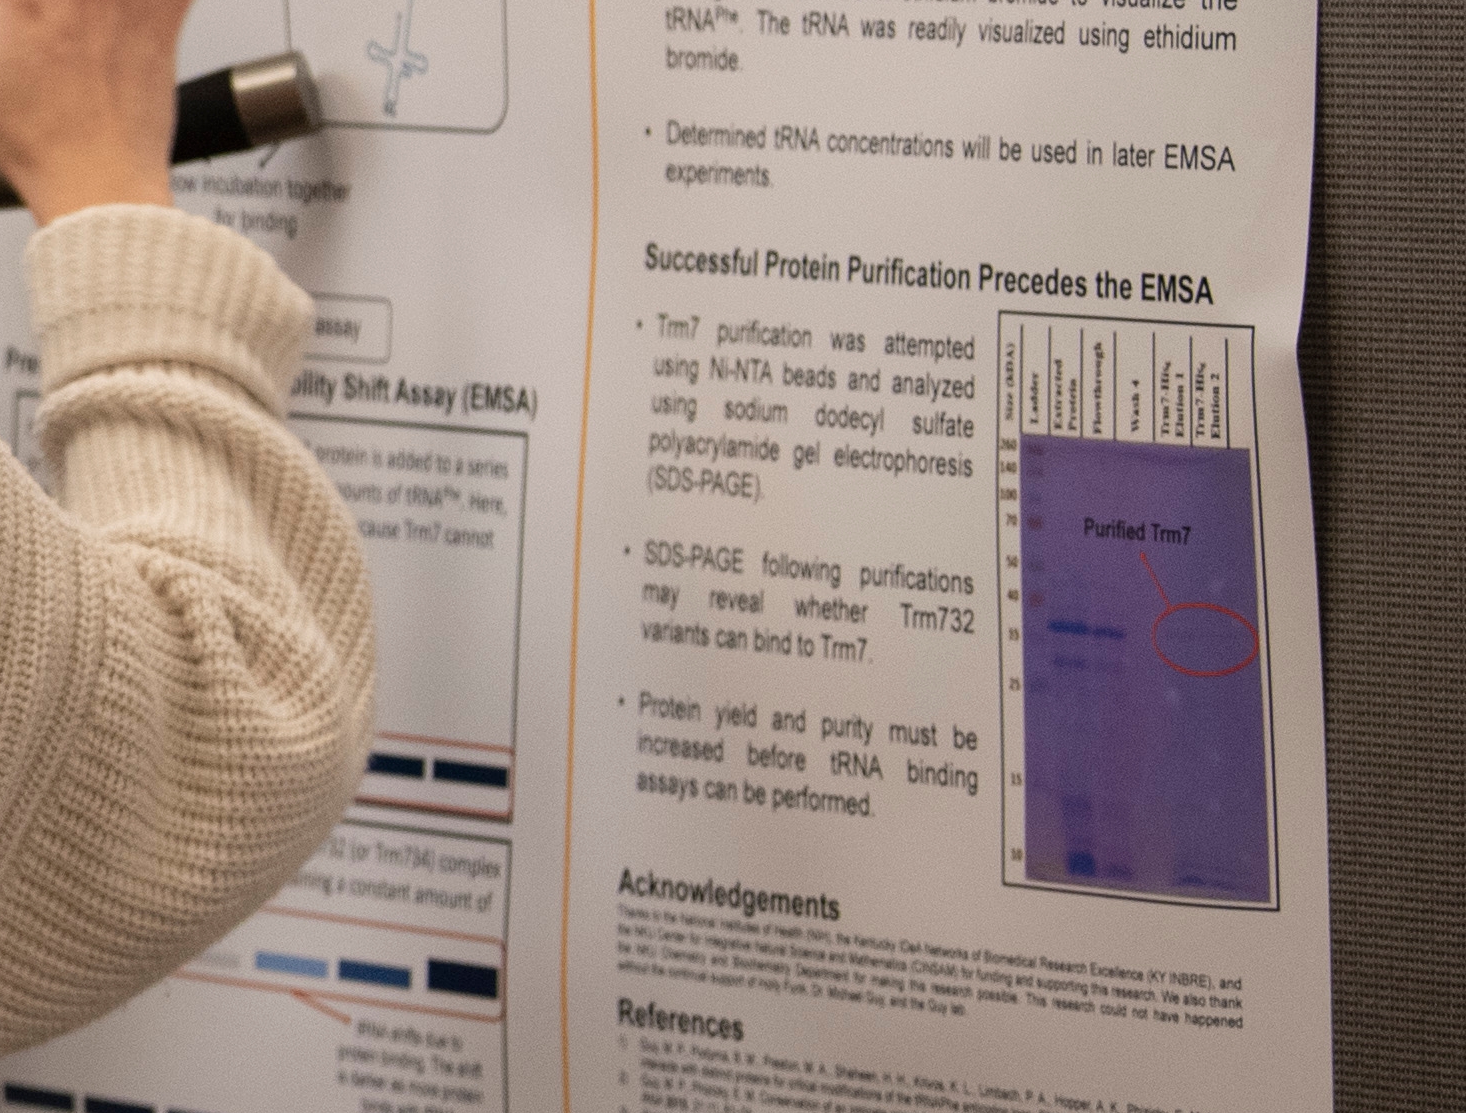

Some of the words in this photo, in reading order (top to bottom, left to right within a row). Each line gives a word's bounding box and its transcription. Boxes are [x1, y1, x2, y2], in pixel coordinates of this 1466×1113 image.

[756, 7, 791, 36] The
[801, 9, 850, 37] tRNA
[860, 18, 897, 40] was
[908, 16, 967, 47] readily
[978, 20, 1066, 46] visualized
[1078, 25, 1131, 55] using
[1142, 23, 1238, 51] ethidium
[665, 118, 767, 150] Determined
[773, 123, 821, 152] tRNA
[826, 132, 955, 158] concentrations
[961, 135, 991, 160] will
[998, 136, 1023, 163] be
[1030, 140, 1078, 165] used
[1086, 139, 1104, 166] in
[1112, 142, 1155, 169] later
[1163, 142, 1236, 172] EMSA
[645, 242, 758, 275] Successful
[764, 248, 841, 281] Protein
[846, 254, 972, 290] Purification
[978, 262, 1088, 298] Precedes
[1094, 269, 1133, 301] the
[1140, 271, 1214, 305] EMSA
[315, 317, 361, 343] assay
[656, 310, 701, 339] Trm7
[715, 319, 813, 348] purification
[829, 331, 867, 353] was
[883, 332, 976, 362] attempted
[341, 371, 391, 403] Shift
[393, 377, 457, 415] Assay
[462, 383, 539, 420] (EMSA)
[653, 356, 700, 386] using
[709, 354, 773, 383] Ni-NTA
[781, 363, 837, 390] beads
[846, 368, 882, 394] and
[891, 373, 976, 403] analyzed
[1131, 379, 1140, 387] 4
[1211, 373, 1220, 381] 2
[650, 394, 698, 424] using
[723, 397, 789, 423] sodium
[814, 403, 885, 436] dodecyl
[911, 410, 975, 439] sulfate
[1068, 378, 1077, 430] Protein
[1131, 393, 1140, 432] Wash
[1175, 385, 1184, 437] Elution
[1211, 384, 1220, 439] Elution
[647, 431, 781, 462] polyacrylamide
[792, 441, 821, 471] gel
[832, 446, 974, 478] electrophoresis
[1083, 515, 1147, 542] Purified
[1150, 521, 1193, 545] Trm7
[644, 538, 744, 574] SDS-PAGE
[761, 551, 842, 588] following
[858, 563, 975, 596] purifications
[642, 581, 680, 611] may
[708, 589, 765, 614] reveal
[794, 595, 869, 624] whether
[899, 600, 976, 635] Trm732
[638, 688, 702, 721] Protein
[714, 703, 758, 730] yield
[770, 709, 807, 735] and
[820, 715, 874, 747] purity
[888, 722, 938, 748] must
[952, 724, 979, 752] be
[637, 734, 725, 763] increased
[746, 742, 807, 772] before
[829, 749, 884, 779] tRNA
[906, 759, 980, 797] binding
[618, 868, 841, 920] Acknowledgements
[618, 996, 744, 1042] References
